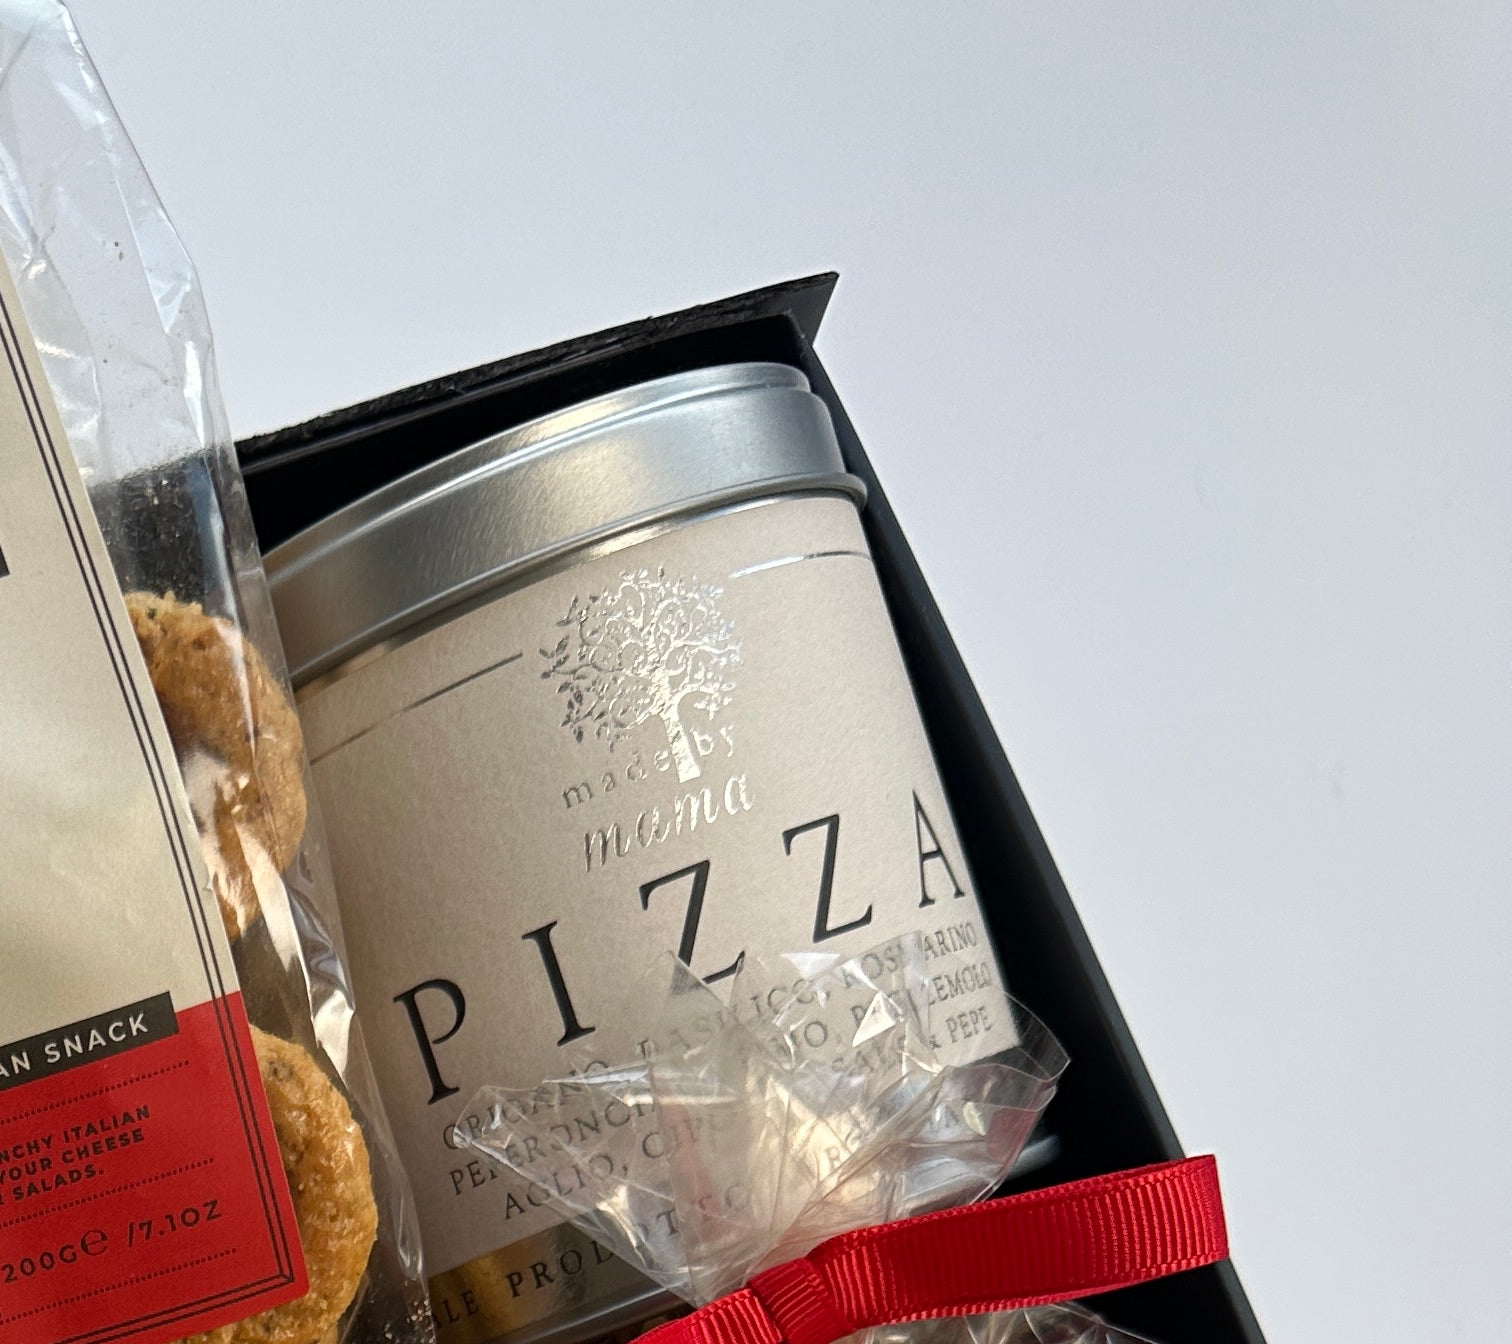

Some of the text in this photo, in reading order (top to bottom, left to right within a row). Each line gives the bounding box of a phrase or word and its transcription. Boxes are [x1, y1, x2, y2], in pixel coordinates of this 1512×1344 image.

[561, 725, 735, 809] made by
[584, 773, 755, 873] mama
[393, 788, 965, 1106] PIZZA
[44, 1011, 150, 1064] SNACK
[945, 1006, 993, 1043] PEPE
[61, 1128, 145, 1165] CHEESE
[63, 1104, 151, 1143] ITALIAN
[12, 1163, 105, 1202] SALADS.
